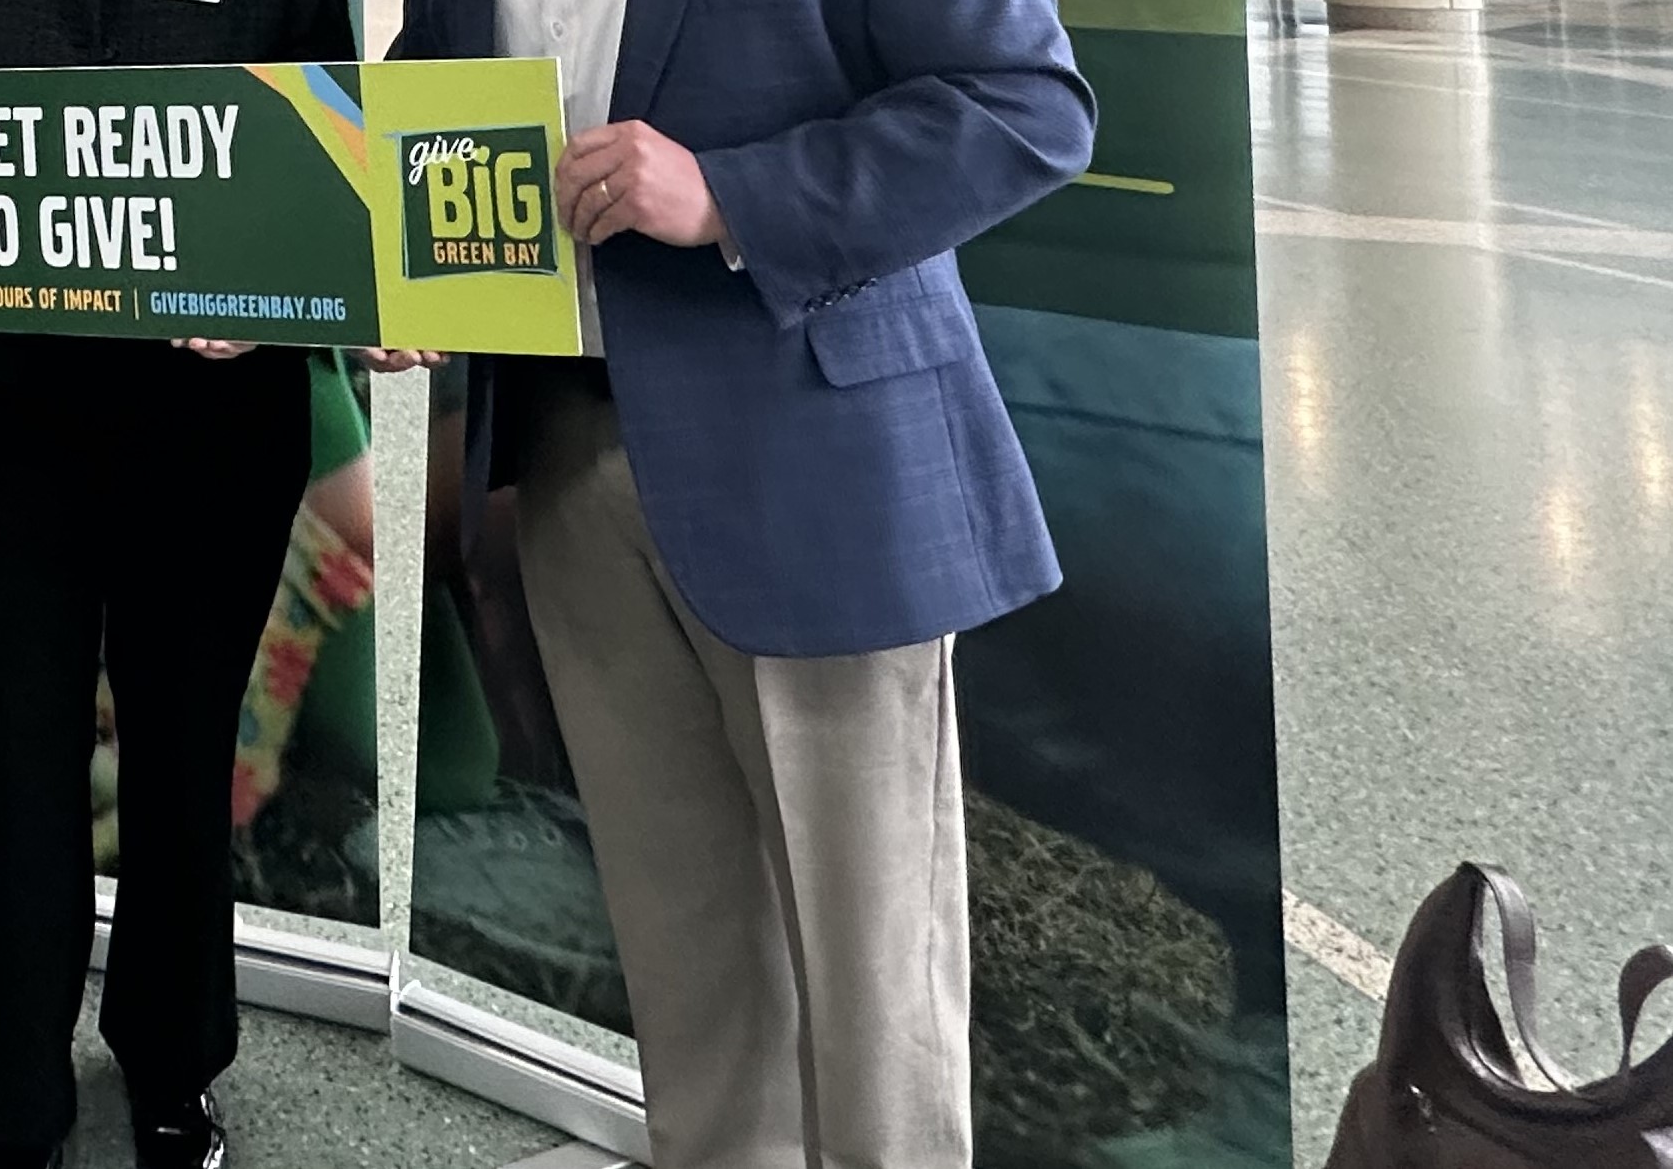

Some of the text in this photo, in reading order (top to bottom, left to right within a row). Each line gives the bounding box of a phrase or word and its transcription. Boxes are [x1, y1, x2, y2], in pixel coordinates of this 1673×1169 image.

[63, 104, 239, 179] READY
[408, 134, 478, 185] give
[38, 195, 177, 271] GIVE!
[433, 241, 541, 266] GREEN BAY
[38, 288, 57, 310] OF
[63, 288, 122, 313] IMPACT
[150, 291, 346, 321] GIVEBIGGREENBAY.ORG
